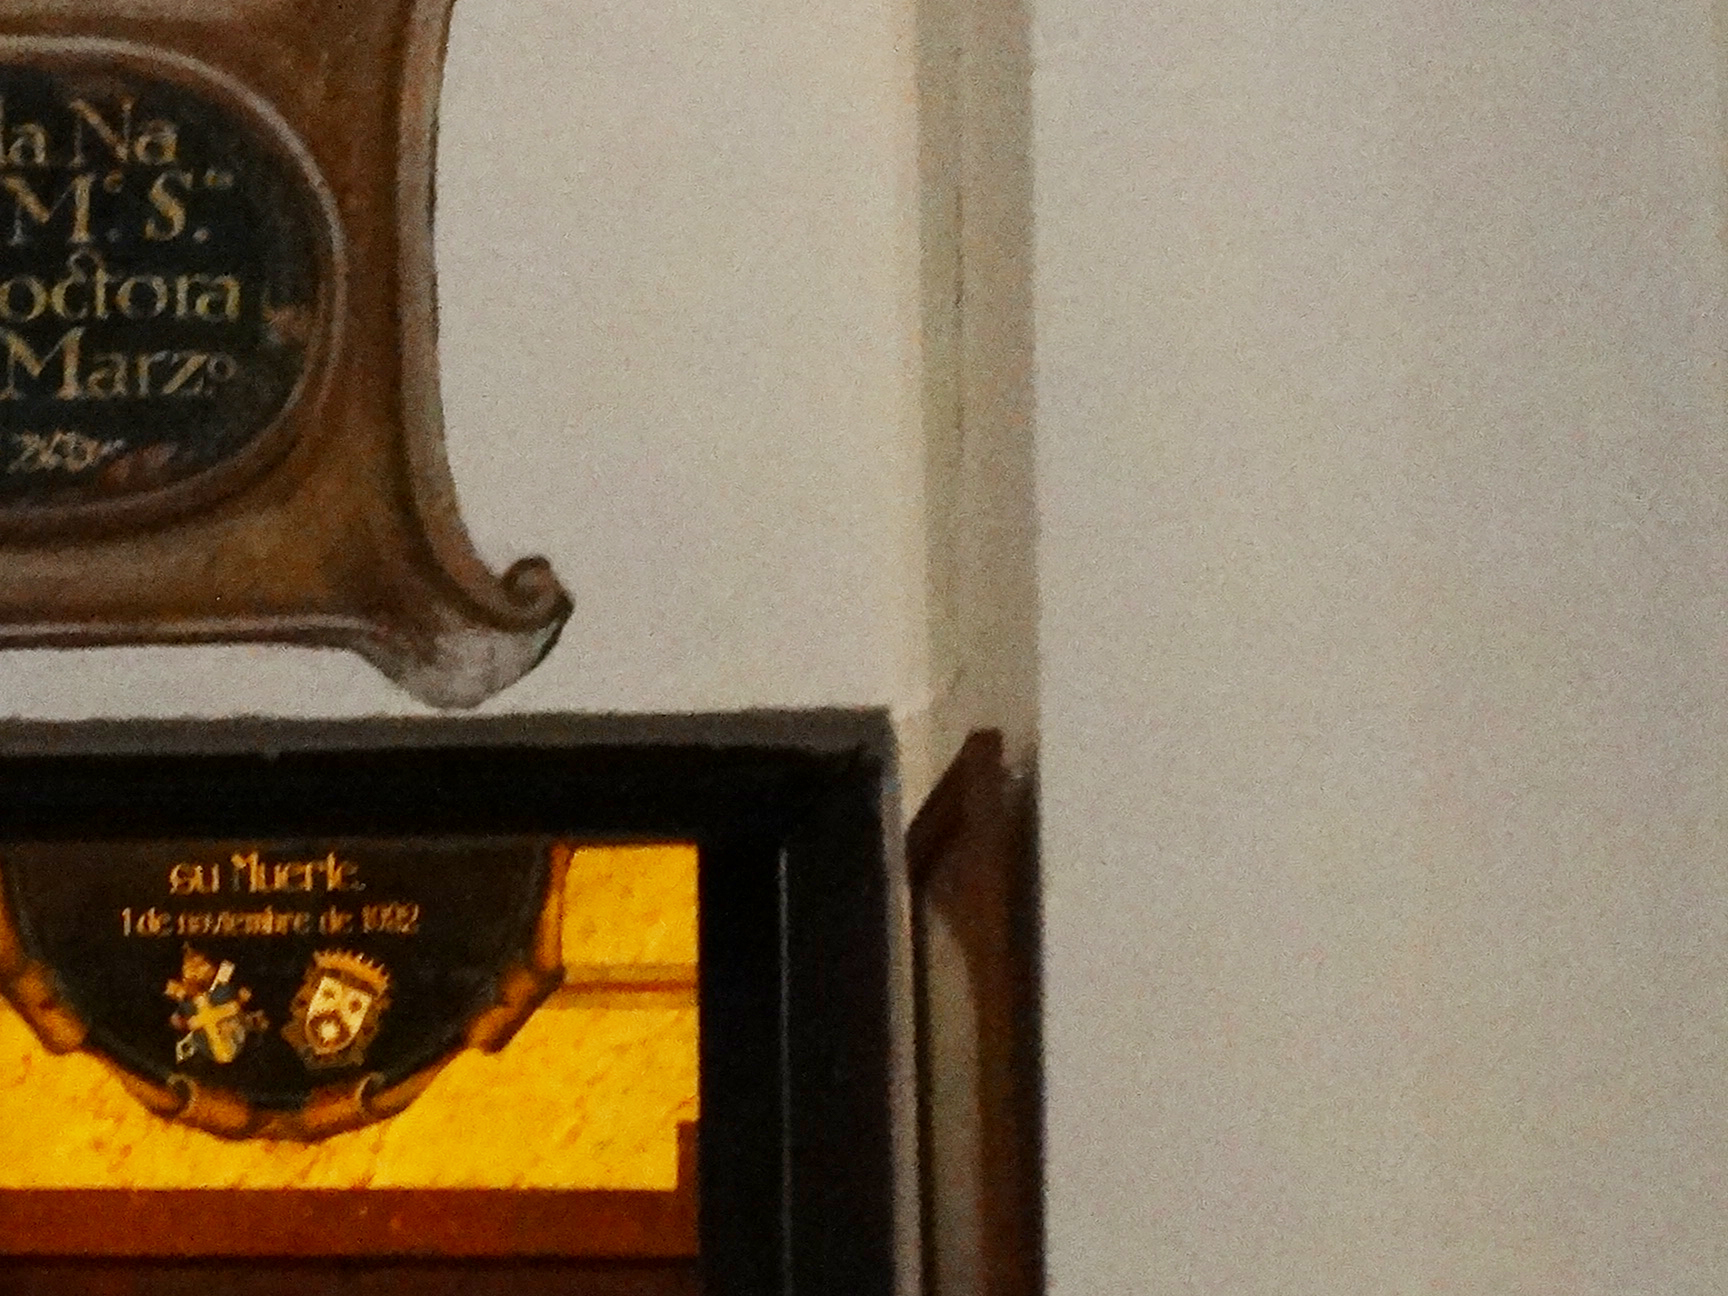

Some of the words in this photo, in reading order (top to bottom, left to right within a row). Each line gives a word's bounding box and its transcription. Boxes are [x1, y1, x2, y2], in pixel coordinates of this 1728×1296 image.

[70, 98, 179, 167] Na
[168, 861, 221, 895] su
[136, 906, 174, 937] de
[318, 905, 356, 935] de
